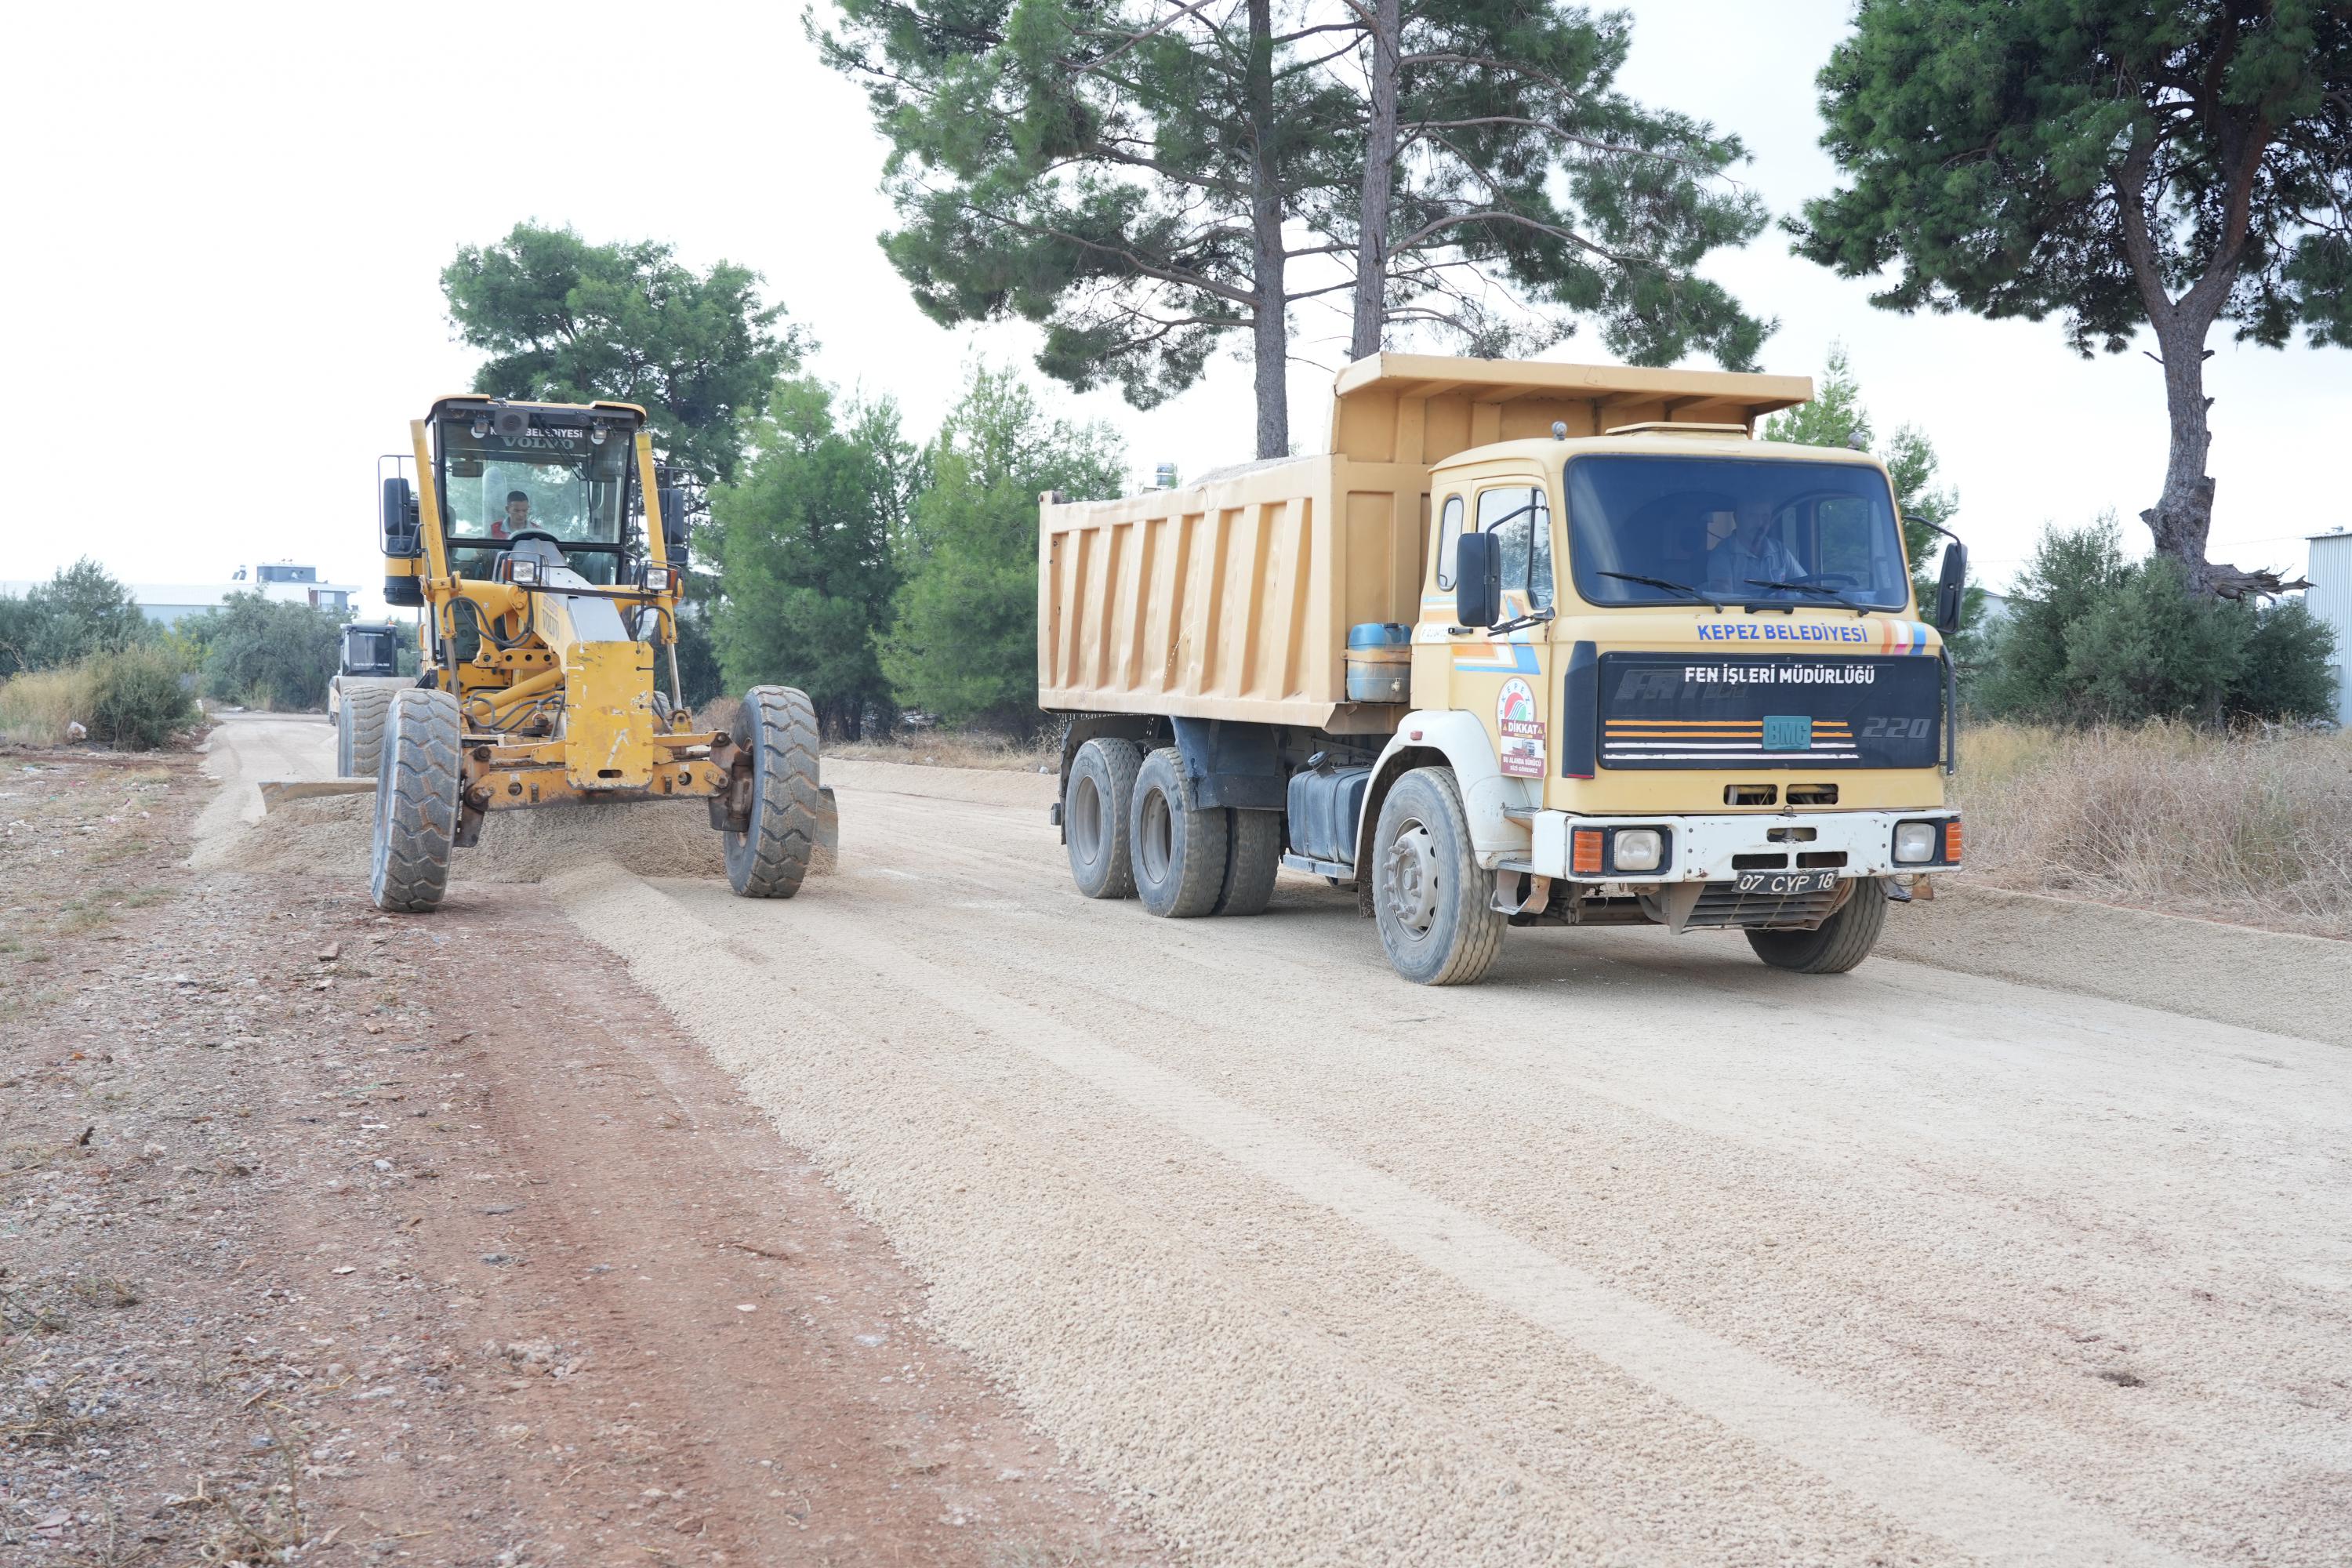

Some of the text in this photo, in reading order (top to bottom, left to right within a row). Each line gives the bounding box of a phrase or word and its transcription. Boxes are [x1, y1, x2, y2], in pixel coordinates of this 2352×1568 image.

[502, 437, 575, 450] VOLVO
[1697, 622, 1868, 643] KEPEZ BELEDİYESİ
[1685, 663, 1875, 685] FEN İŞLERİ MÜDÜRLÜĞÜ
[1501, 683, 1530, 704] KEPEZ
[1508, 720, 1538, 735] DİKKAT
[1768, 721, 1808, 746] BMC
[1861, 717, 1932, 739] 220
[1740, 873, 1835, 892] 07 CYP 18
